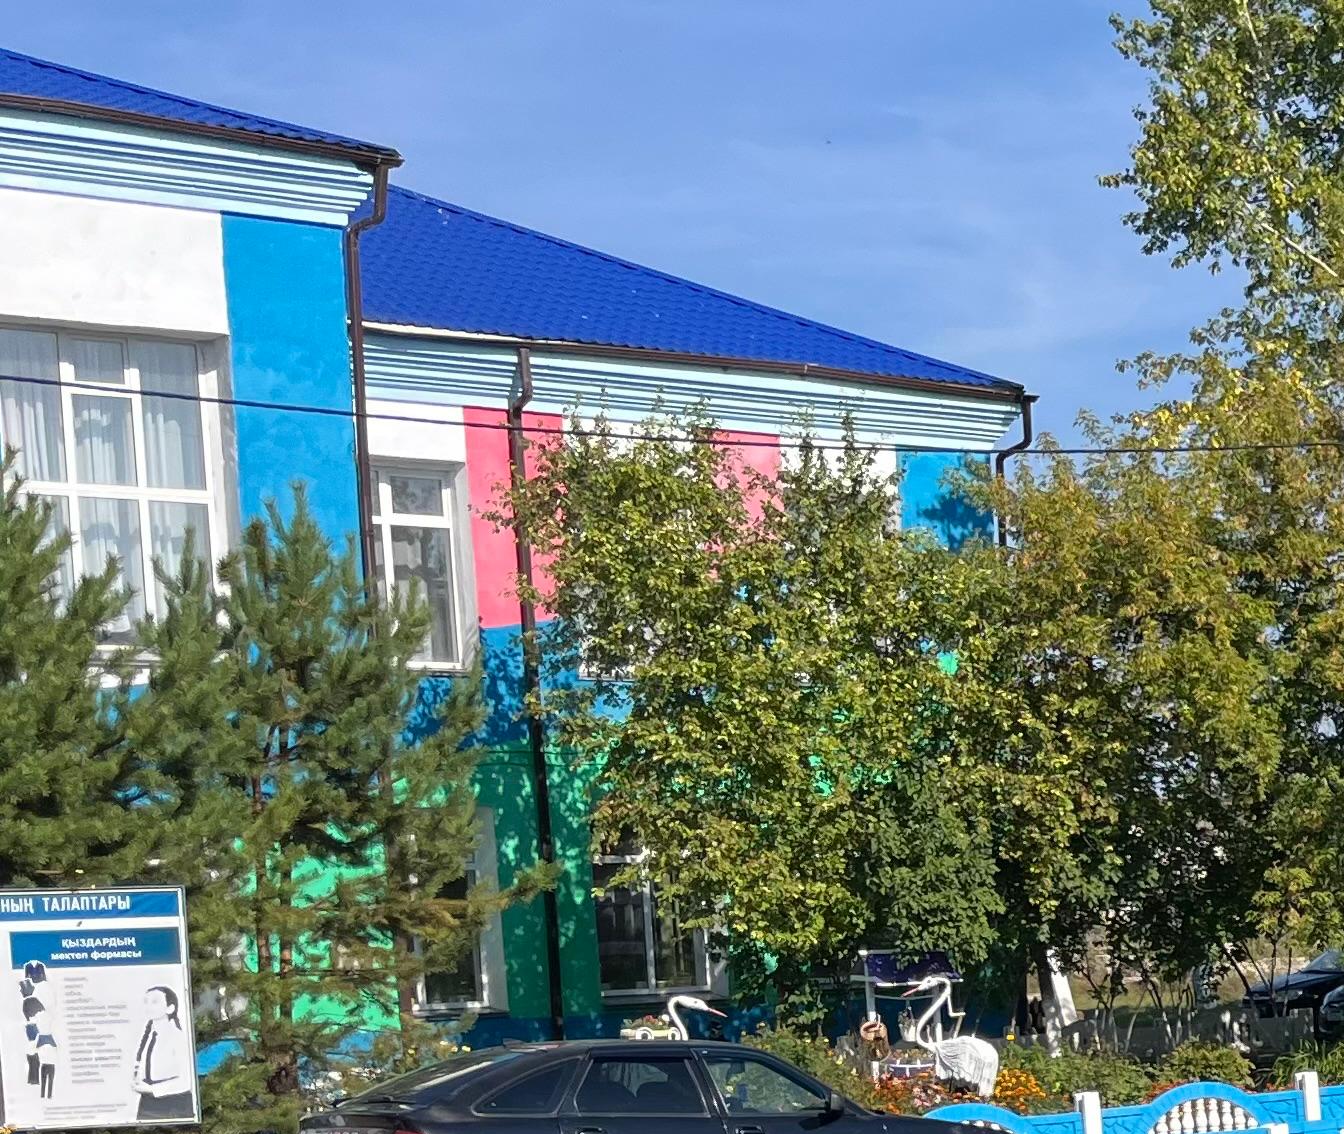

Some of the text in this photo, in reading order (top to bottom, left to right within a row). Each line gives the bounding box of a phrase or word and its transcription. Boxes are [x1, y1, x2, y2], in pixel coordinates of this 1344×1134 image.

[42, 895, 131, 912] ТАЛАПТАРЫ
[61, 937, 137, 949] ҚЫЗДАРДЫҢ
[90, 950, 142, 961] формасы
